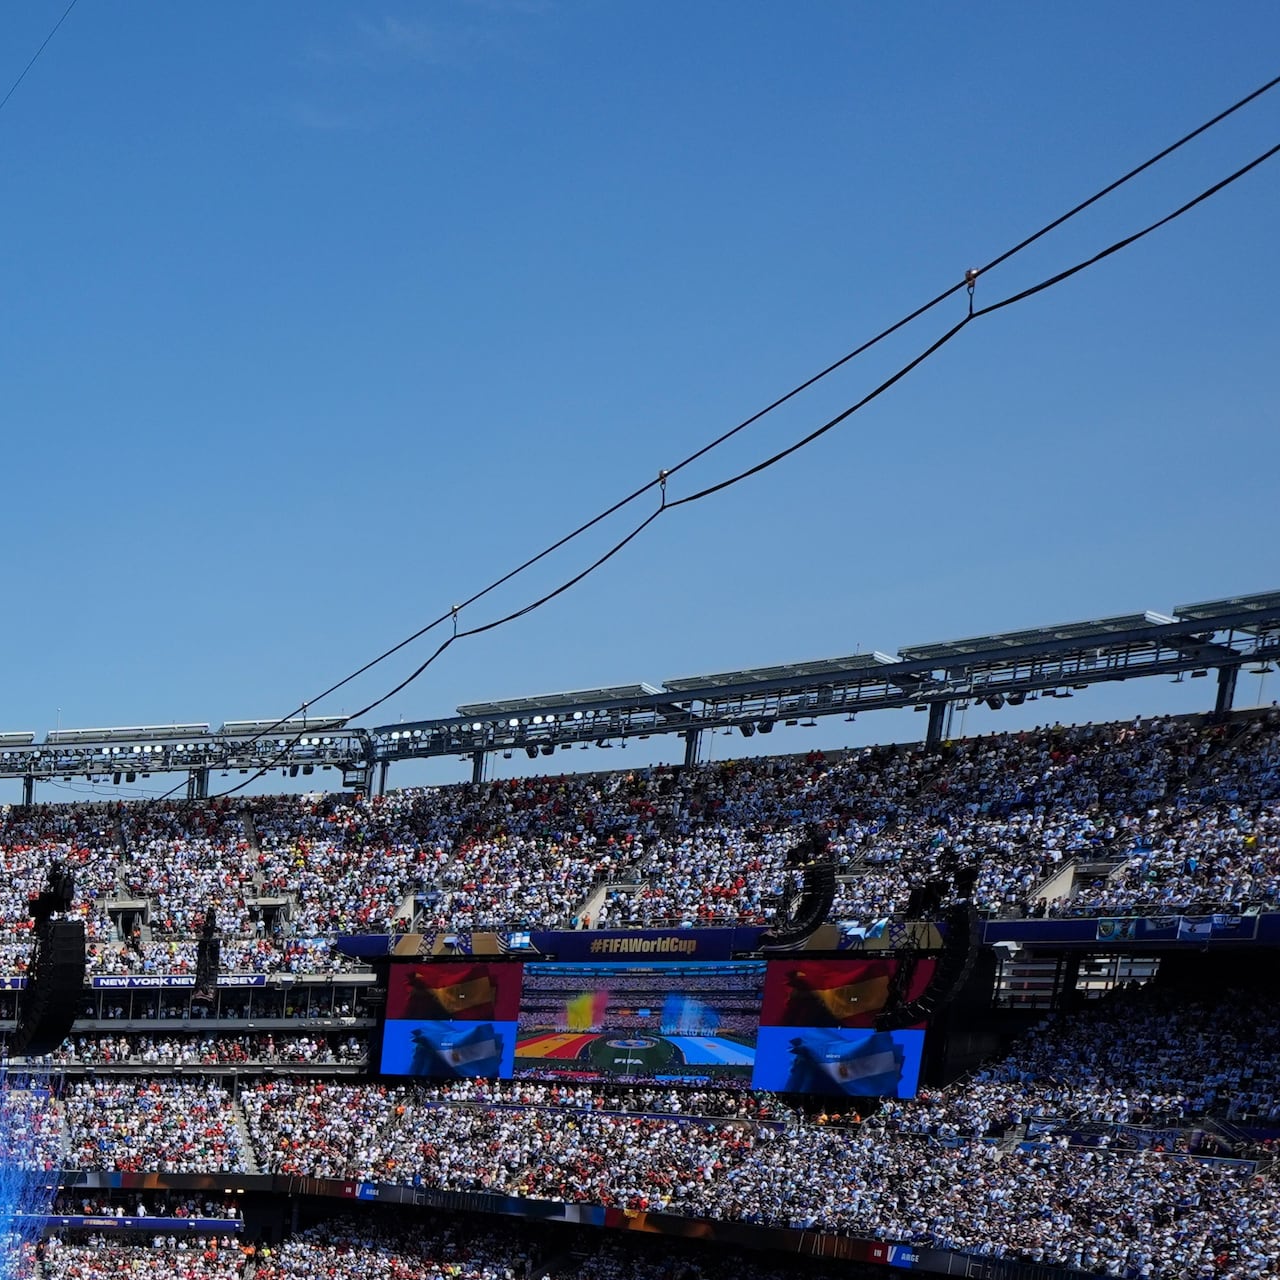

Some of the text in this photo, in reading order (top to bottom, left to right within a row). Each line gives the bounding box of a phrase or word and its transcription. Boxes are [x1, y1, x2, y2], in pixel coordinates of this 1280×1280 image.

[590, 937, 698, 954] #FIFAWorldCup
[100, 977, 129, 986] NEW
[131, 977, 169, 986] YORK
[887, 1246, 897, 1262] V
